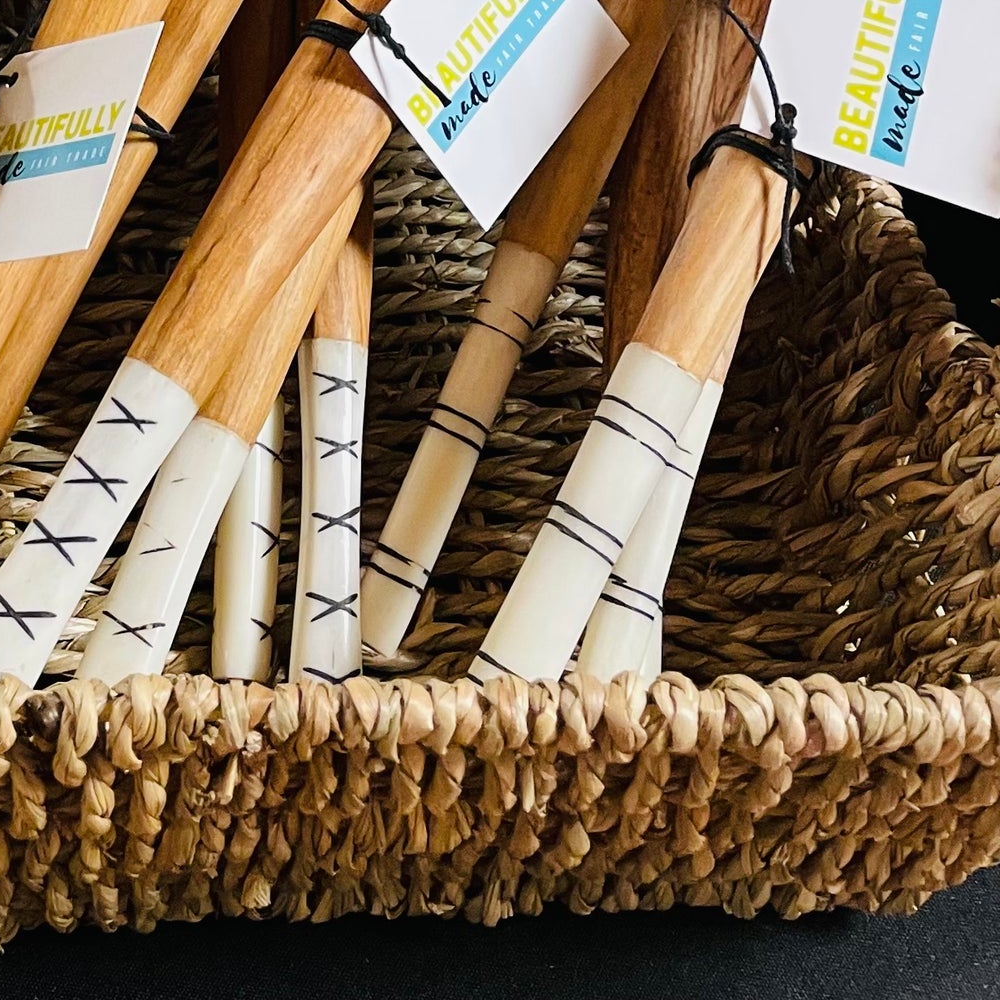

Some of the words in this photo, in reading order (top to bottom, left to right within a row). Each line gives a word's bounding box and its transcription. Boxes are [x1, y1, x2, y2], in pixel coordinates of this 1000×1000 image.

[441, 69, 497, 141] made
[496, 33, 525, 67] FAIR
[882, 60, 925, 153] made
[908, 10, 929, 53] FAIR
